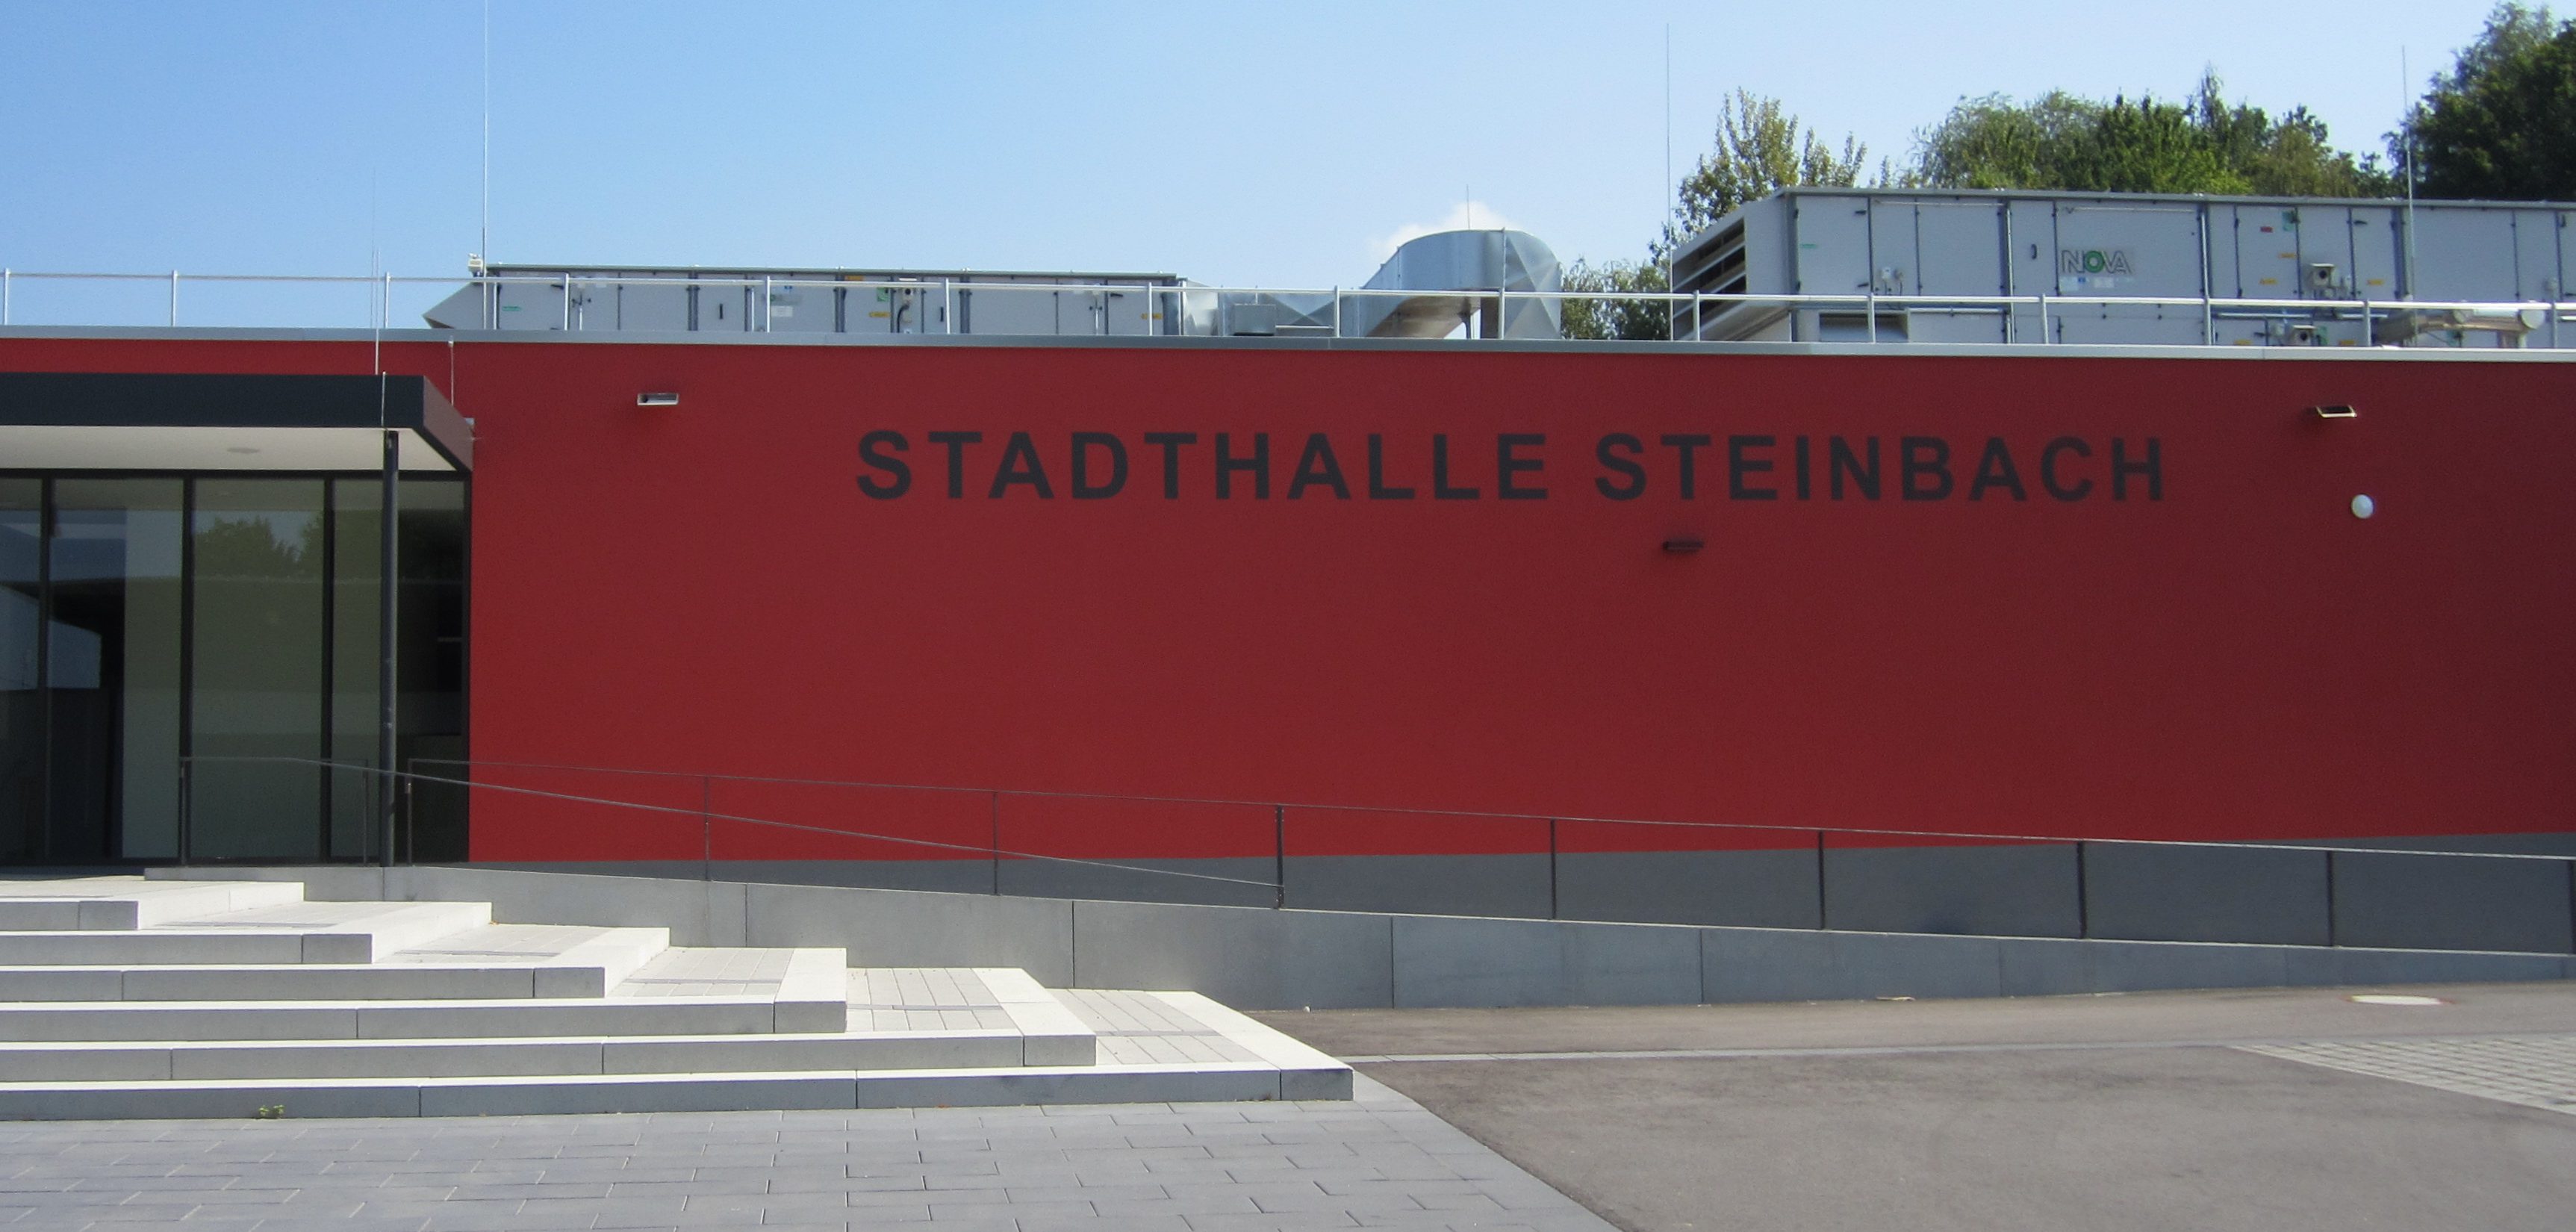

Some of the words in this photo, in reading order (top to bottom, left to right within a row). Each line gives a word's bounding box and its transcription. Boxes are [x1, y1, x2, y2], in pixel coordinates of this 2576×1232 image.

[2062, 249, 2134, 274] NOVA
[856, 429, 1550, 501] STADTHALLE
[1594, 432, 2165, 503] STEINBACH
